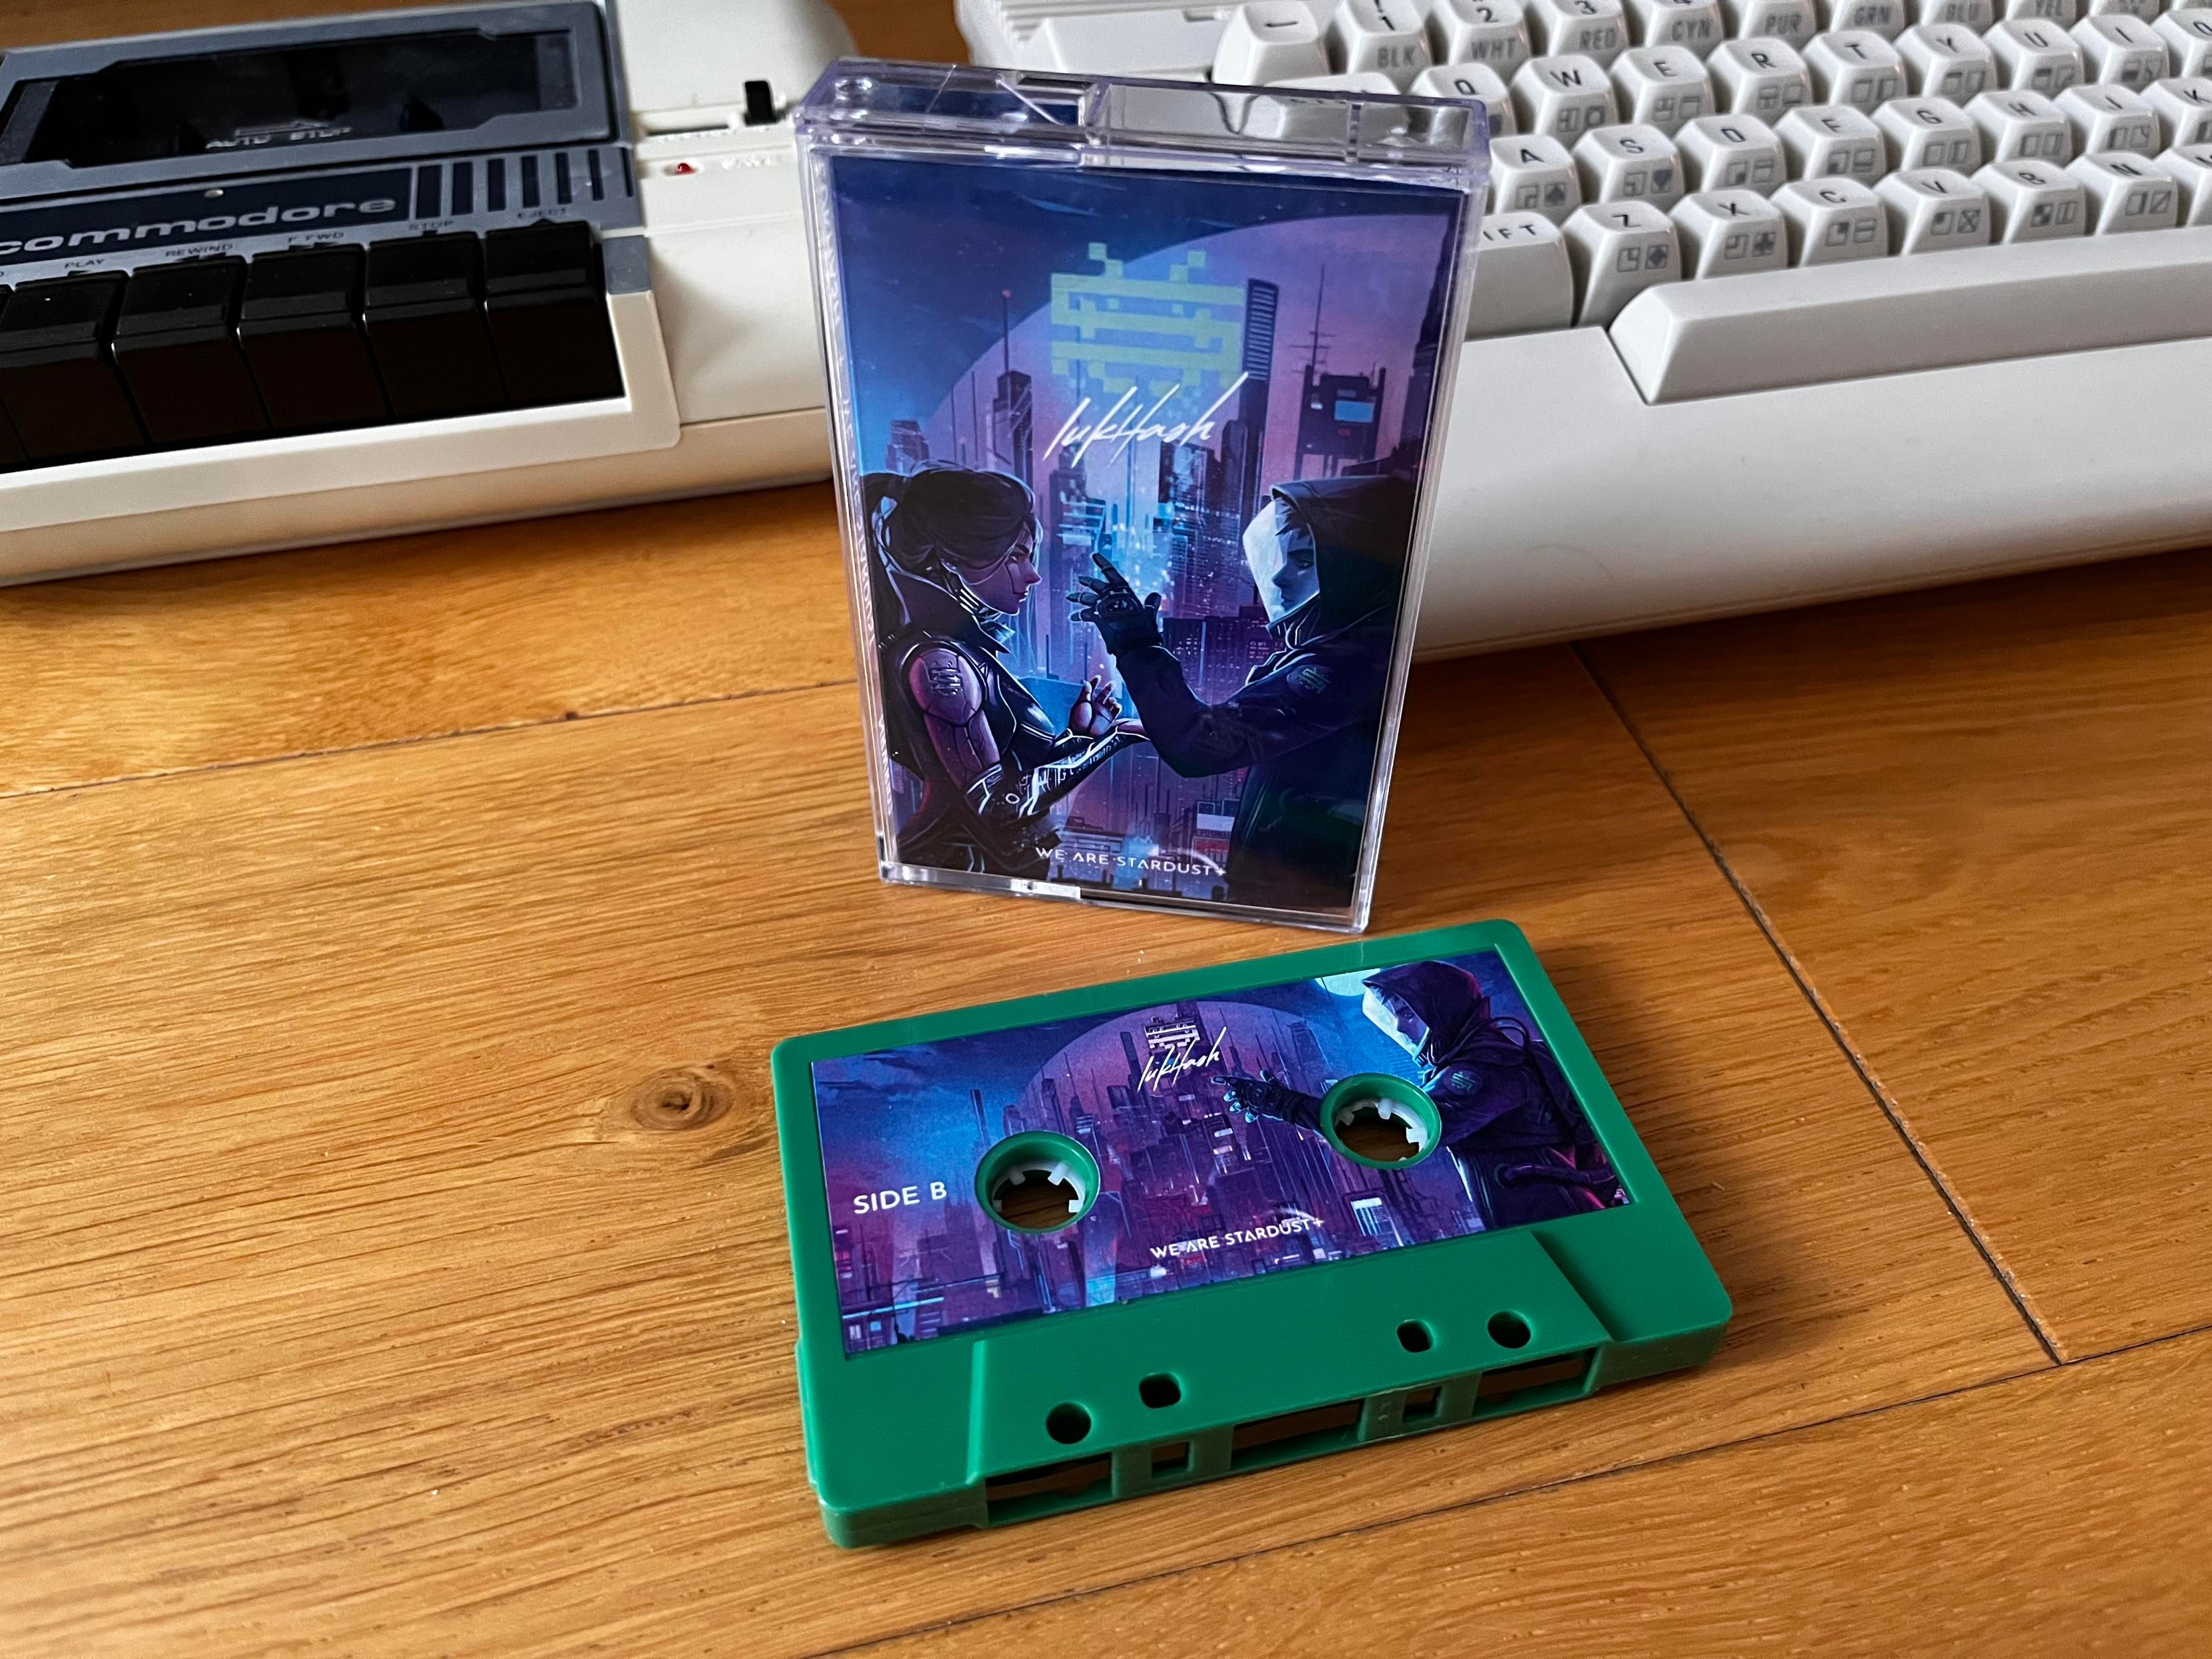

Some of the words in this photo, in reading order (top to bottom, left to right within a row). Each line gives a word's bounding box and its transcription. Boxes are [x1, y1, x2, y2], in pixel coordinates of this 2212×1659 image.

[1476, 7, 1500, 23] 2
[1574, 1, 1597, 15] 3
[1765, 14, 1802, 34] PUR
[1854, 6, 1892, 27] GRN
[1671, 18, 1712, 41] CYN
[1579, 29, 1618, 50] RED
[1936, 37, 1959, 53] Y
[2024, 32, 2048, 47] U
[1377, 45, 1417, 68] BLK
[1470, 37, 1517, 61] WHT
[1845, 43, 1867, 60] T
[1653, 61, 1678, 77] E
[1751, 53, 1777, 69] R
[1549, 69, 1583, 87] W
[1917, 108, 1944, 124] G
[2008, 102, 2038, 116] H
[1821, 119, 1841, 132] F
[1720, 128, 1746, 143] D
[1619, 138, 1645, 154] S
[1520, 148, 1545, 164] A
[2110, 164, 2143, 176] N
[2018, 172, 2046, 185] B
[1921, 181, 1948, 194] V
[1819, 190, 1847, 203] C
[1718, 203, 1751, 216] X
[0, 199, 396, 255] commodore
[1612, 214, 1643, 228] Z
[1482, 224, 1537, 241] IFT
[166, 243, 233, 257] REWIND
[65, 257, 106, 269] PLAY
[1035, 847, 1066, 860] WE
[1072, 851, 1109, 865] ARE
[1117, 855, 1212, 876] STARDUST
[854, 1185, 921, 1214] SIDE
[930, 1181, 947, 1200] B
[1150, 1243, 1181, 1259] WE
[1186, 1235, 1220, 1253] ARE
[1224, 1218, 1311, 1245] STARDUST
